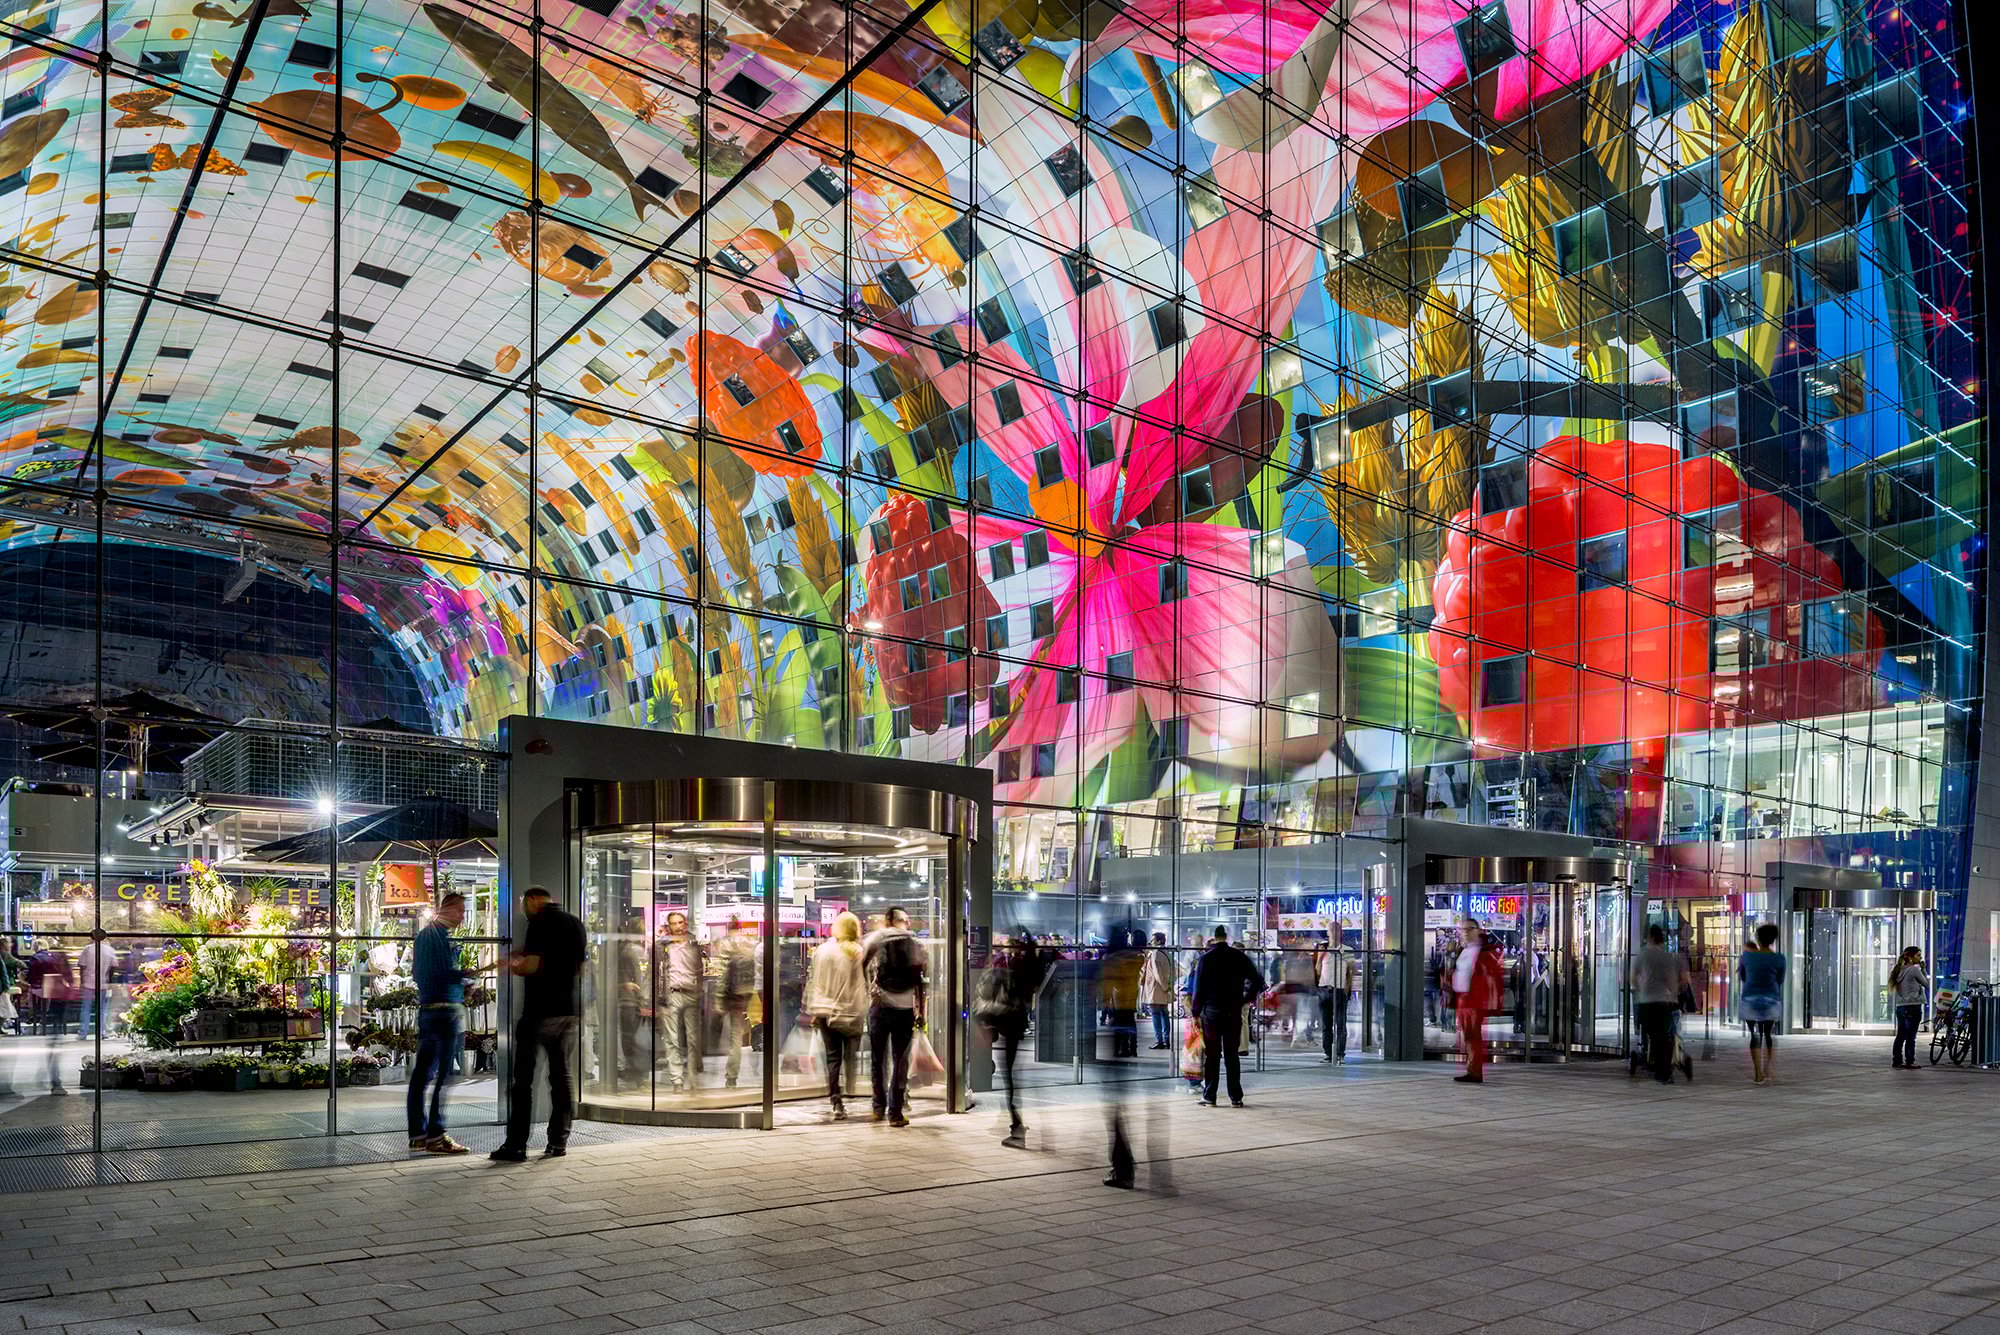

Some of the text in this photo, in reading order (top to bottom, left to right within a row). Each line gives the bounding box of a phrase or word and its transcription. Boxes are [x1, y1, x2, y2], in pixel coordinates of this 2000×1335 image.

[390, 884, 420, 898] kas
[1456, 895, 1517, 915] Adalus Fish
